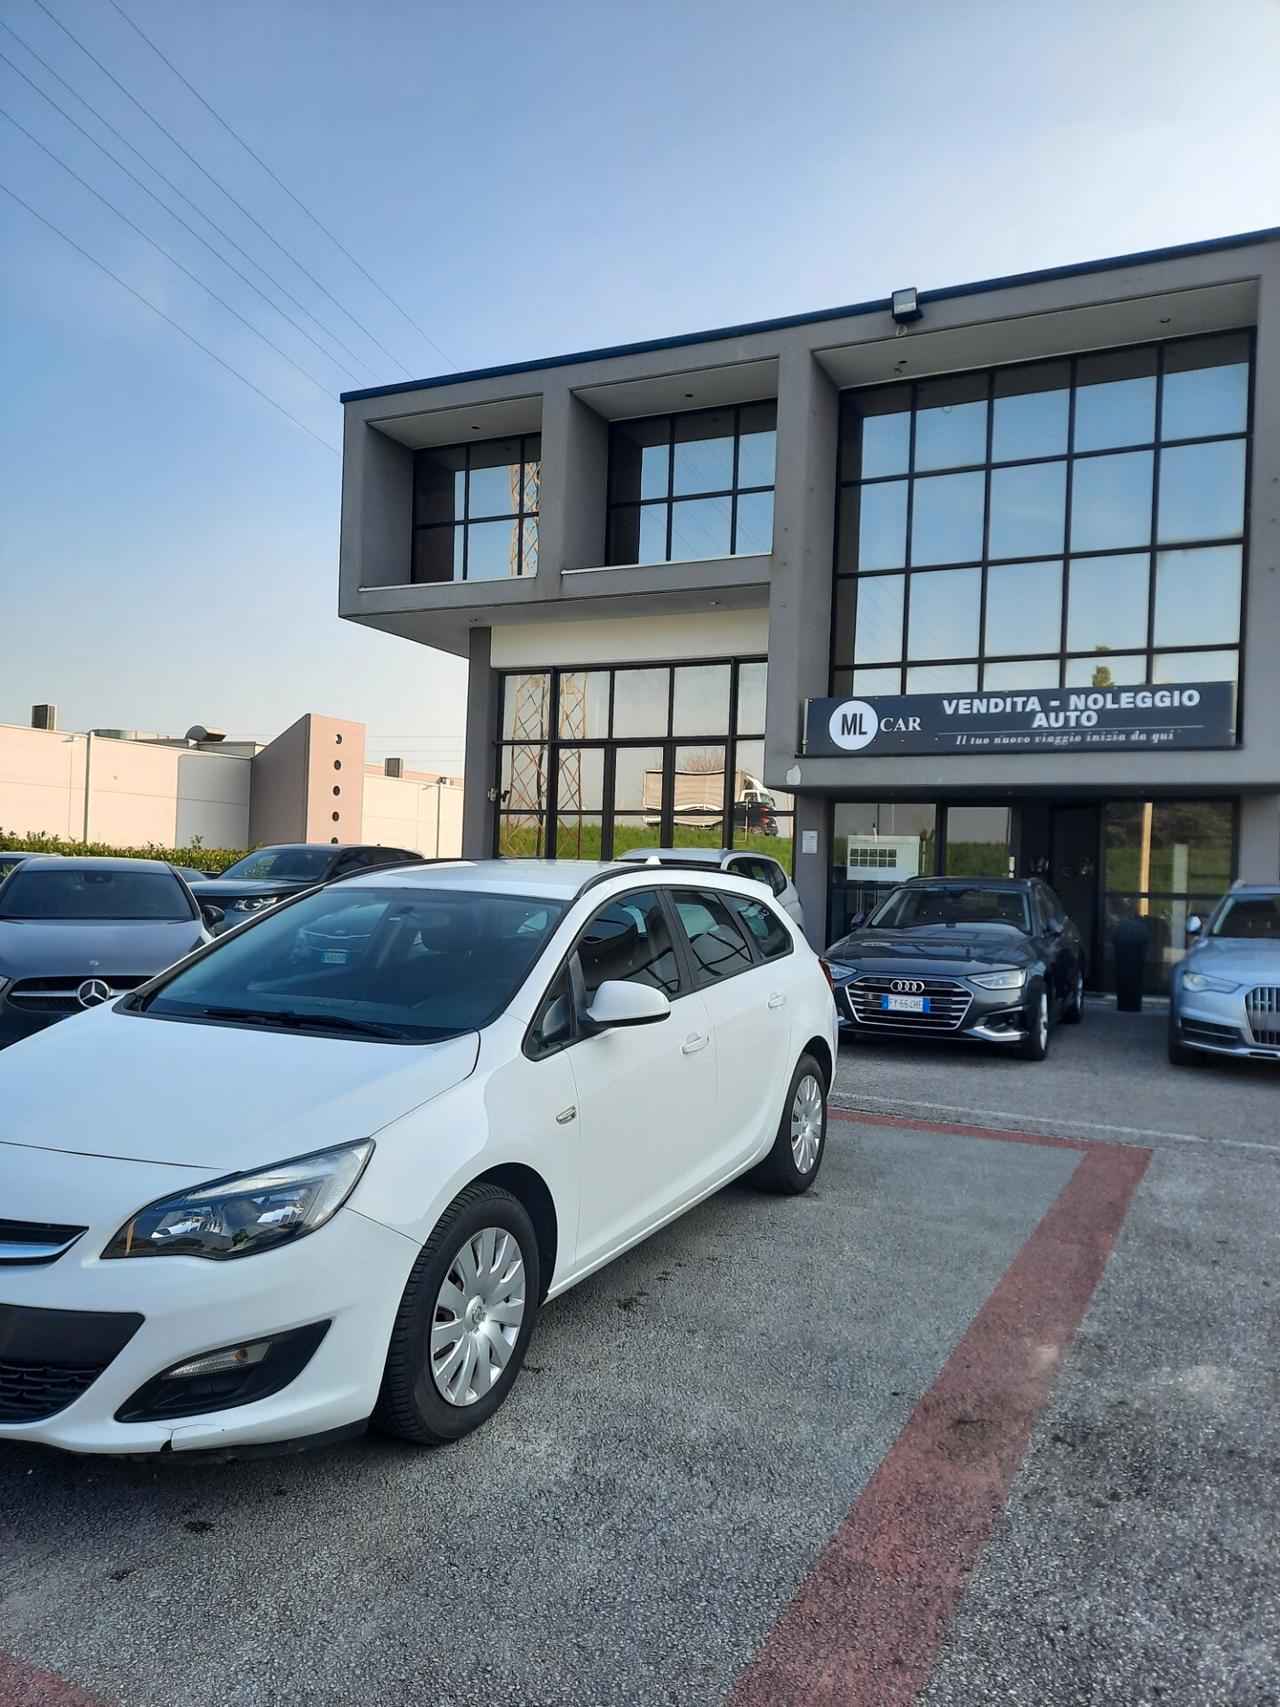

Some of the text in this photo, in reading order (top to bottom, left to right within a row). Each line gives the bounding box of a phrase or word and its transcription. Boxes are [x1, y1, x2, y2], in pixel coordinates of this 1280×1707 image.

[942, 696, 1042, 715] VENDITA
[1069, 689, 1201, 710] NOLEGGIO
[841, 713, 922, 736] ML CAR
[1031, 710, 1099, 729] AUTO
[970, 736, 990, 745] tuo
[994, 736, 1031, 744] nuovo
[1035, 732, 1082, 746] viaggio
[1086, 731, 1126, 742] inizia
[1131, 730, 1147, 741] da
[1151, 729, 1175, 743] qui
